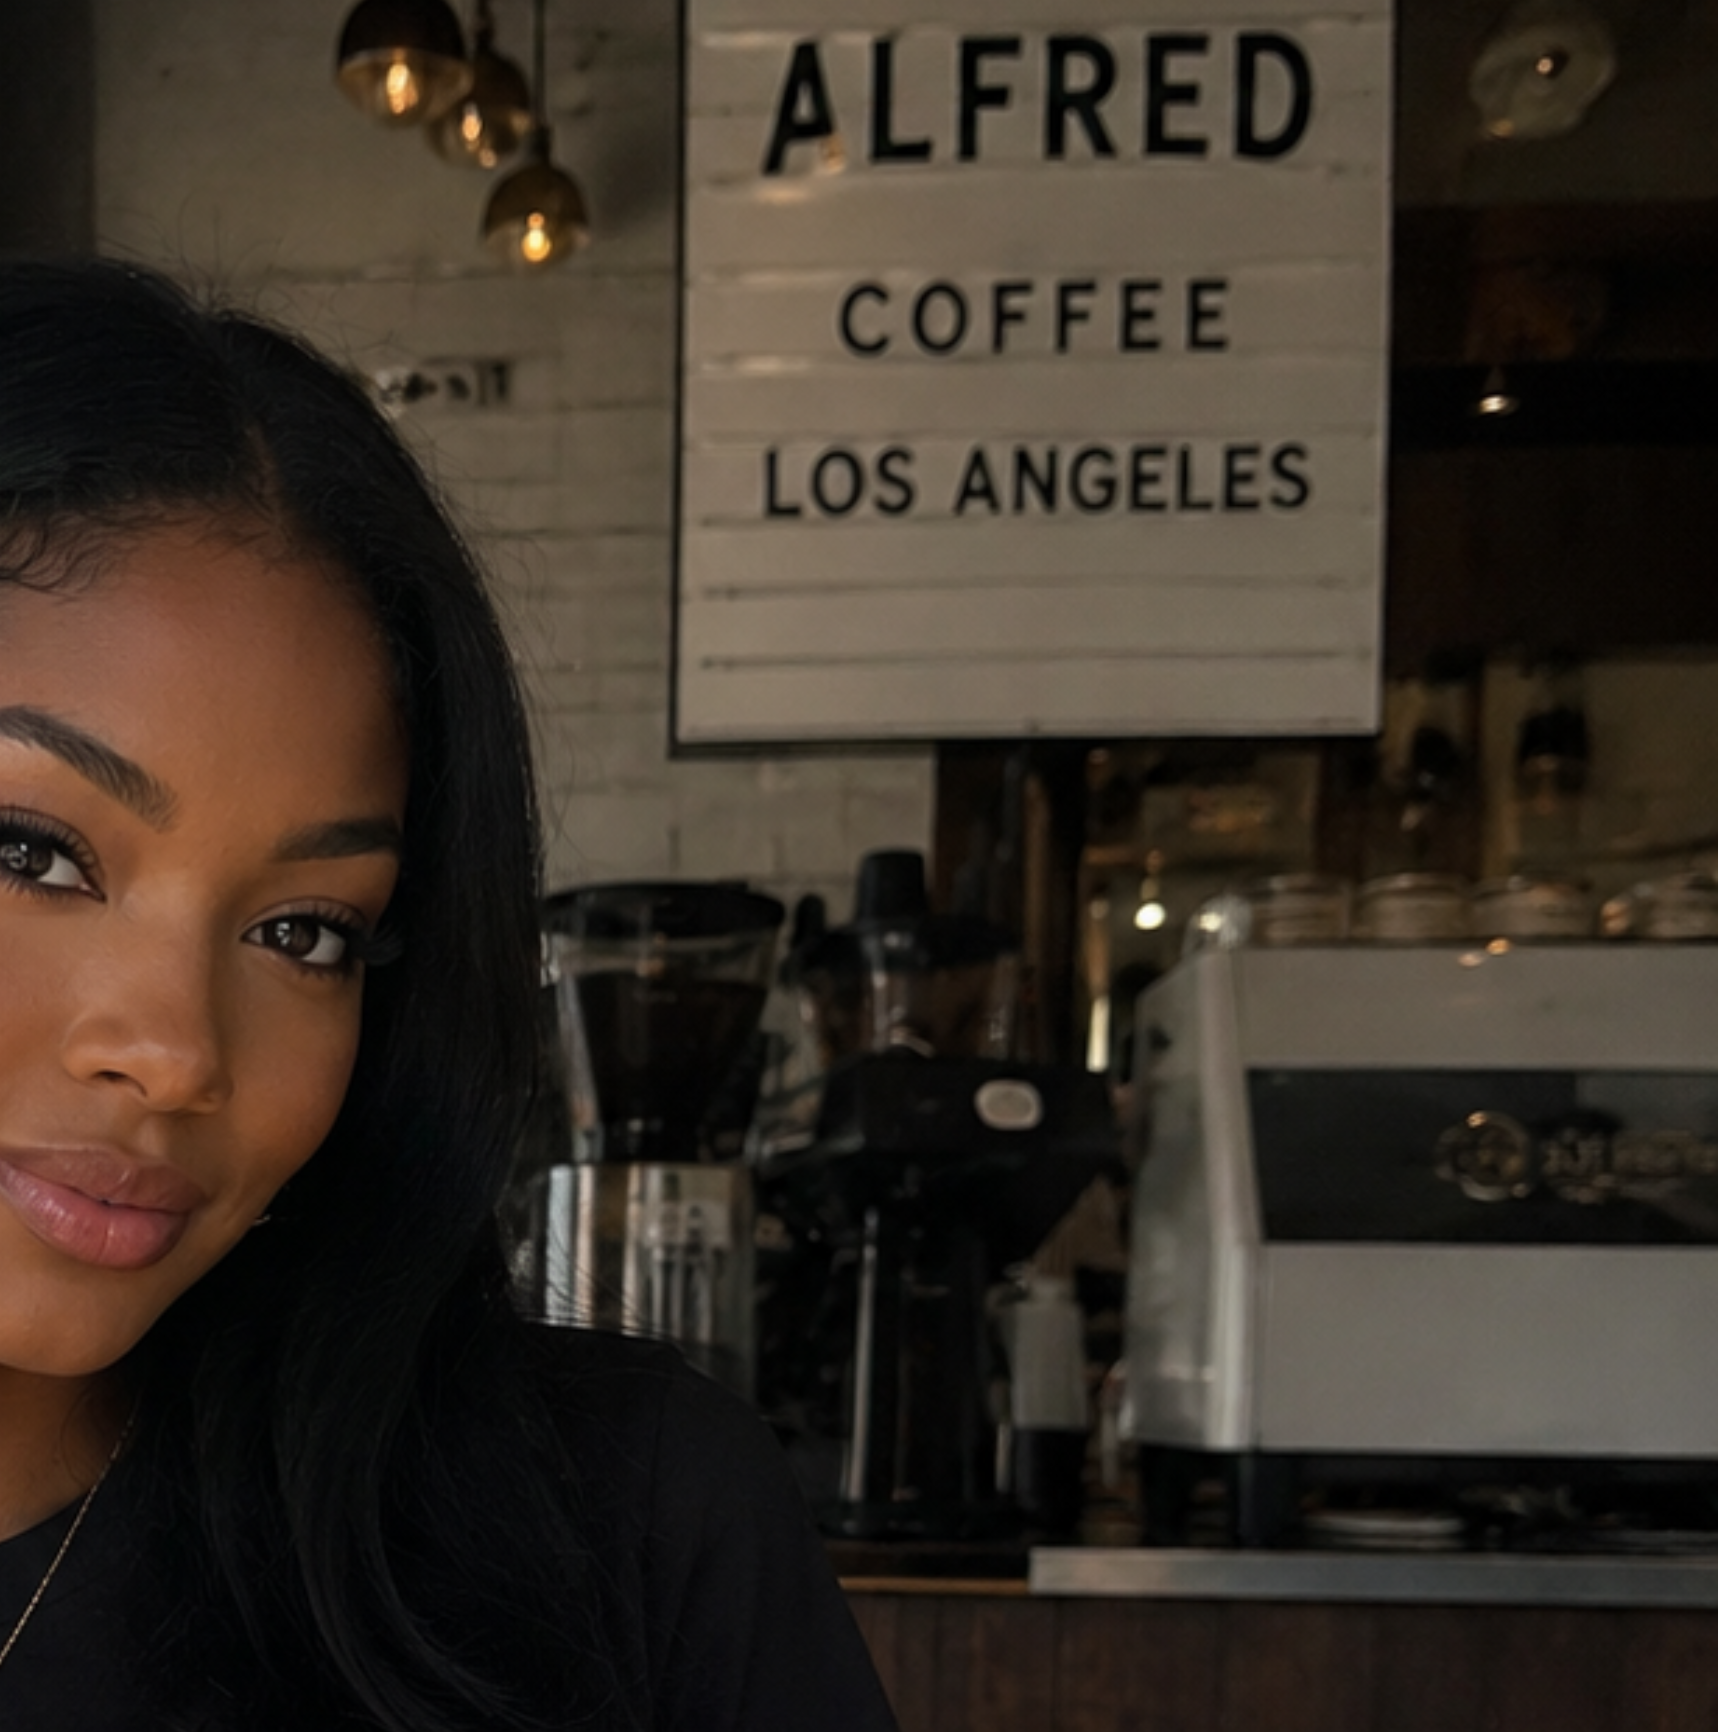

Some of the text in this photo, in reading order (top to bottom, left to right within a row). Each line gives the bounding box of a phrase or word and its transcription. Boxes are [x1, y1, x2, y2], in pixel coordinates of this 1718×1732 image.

[761, 30, 1314, 176] ALFRED
[838, 279, 1231, 358] COFFEE
[763, 443, 1311, 519] LOS ANGELES
